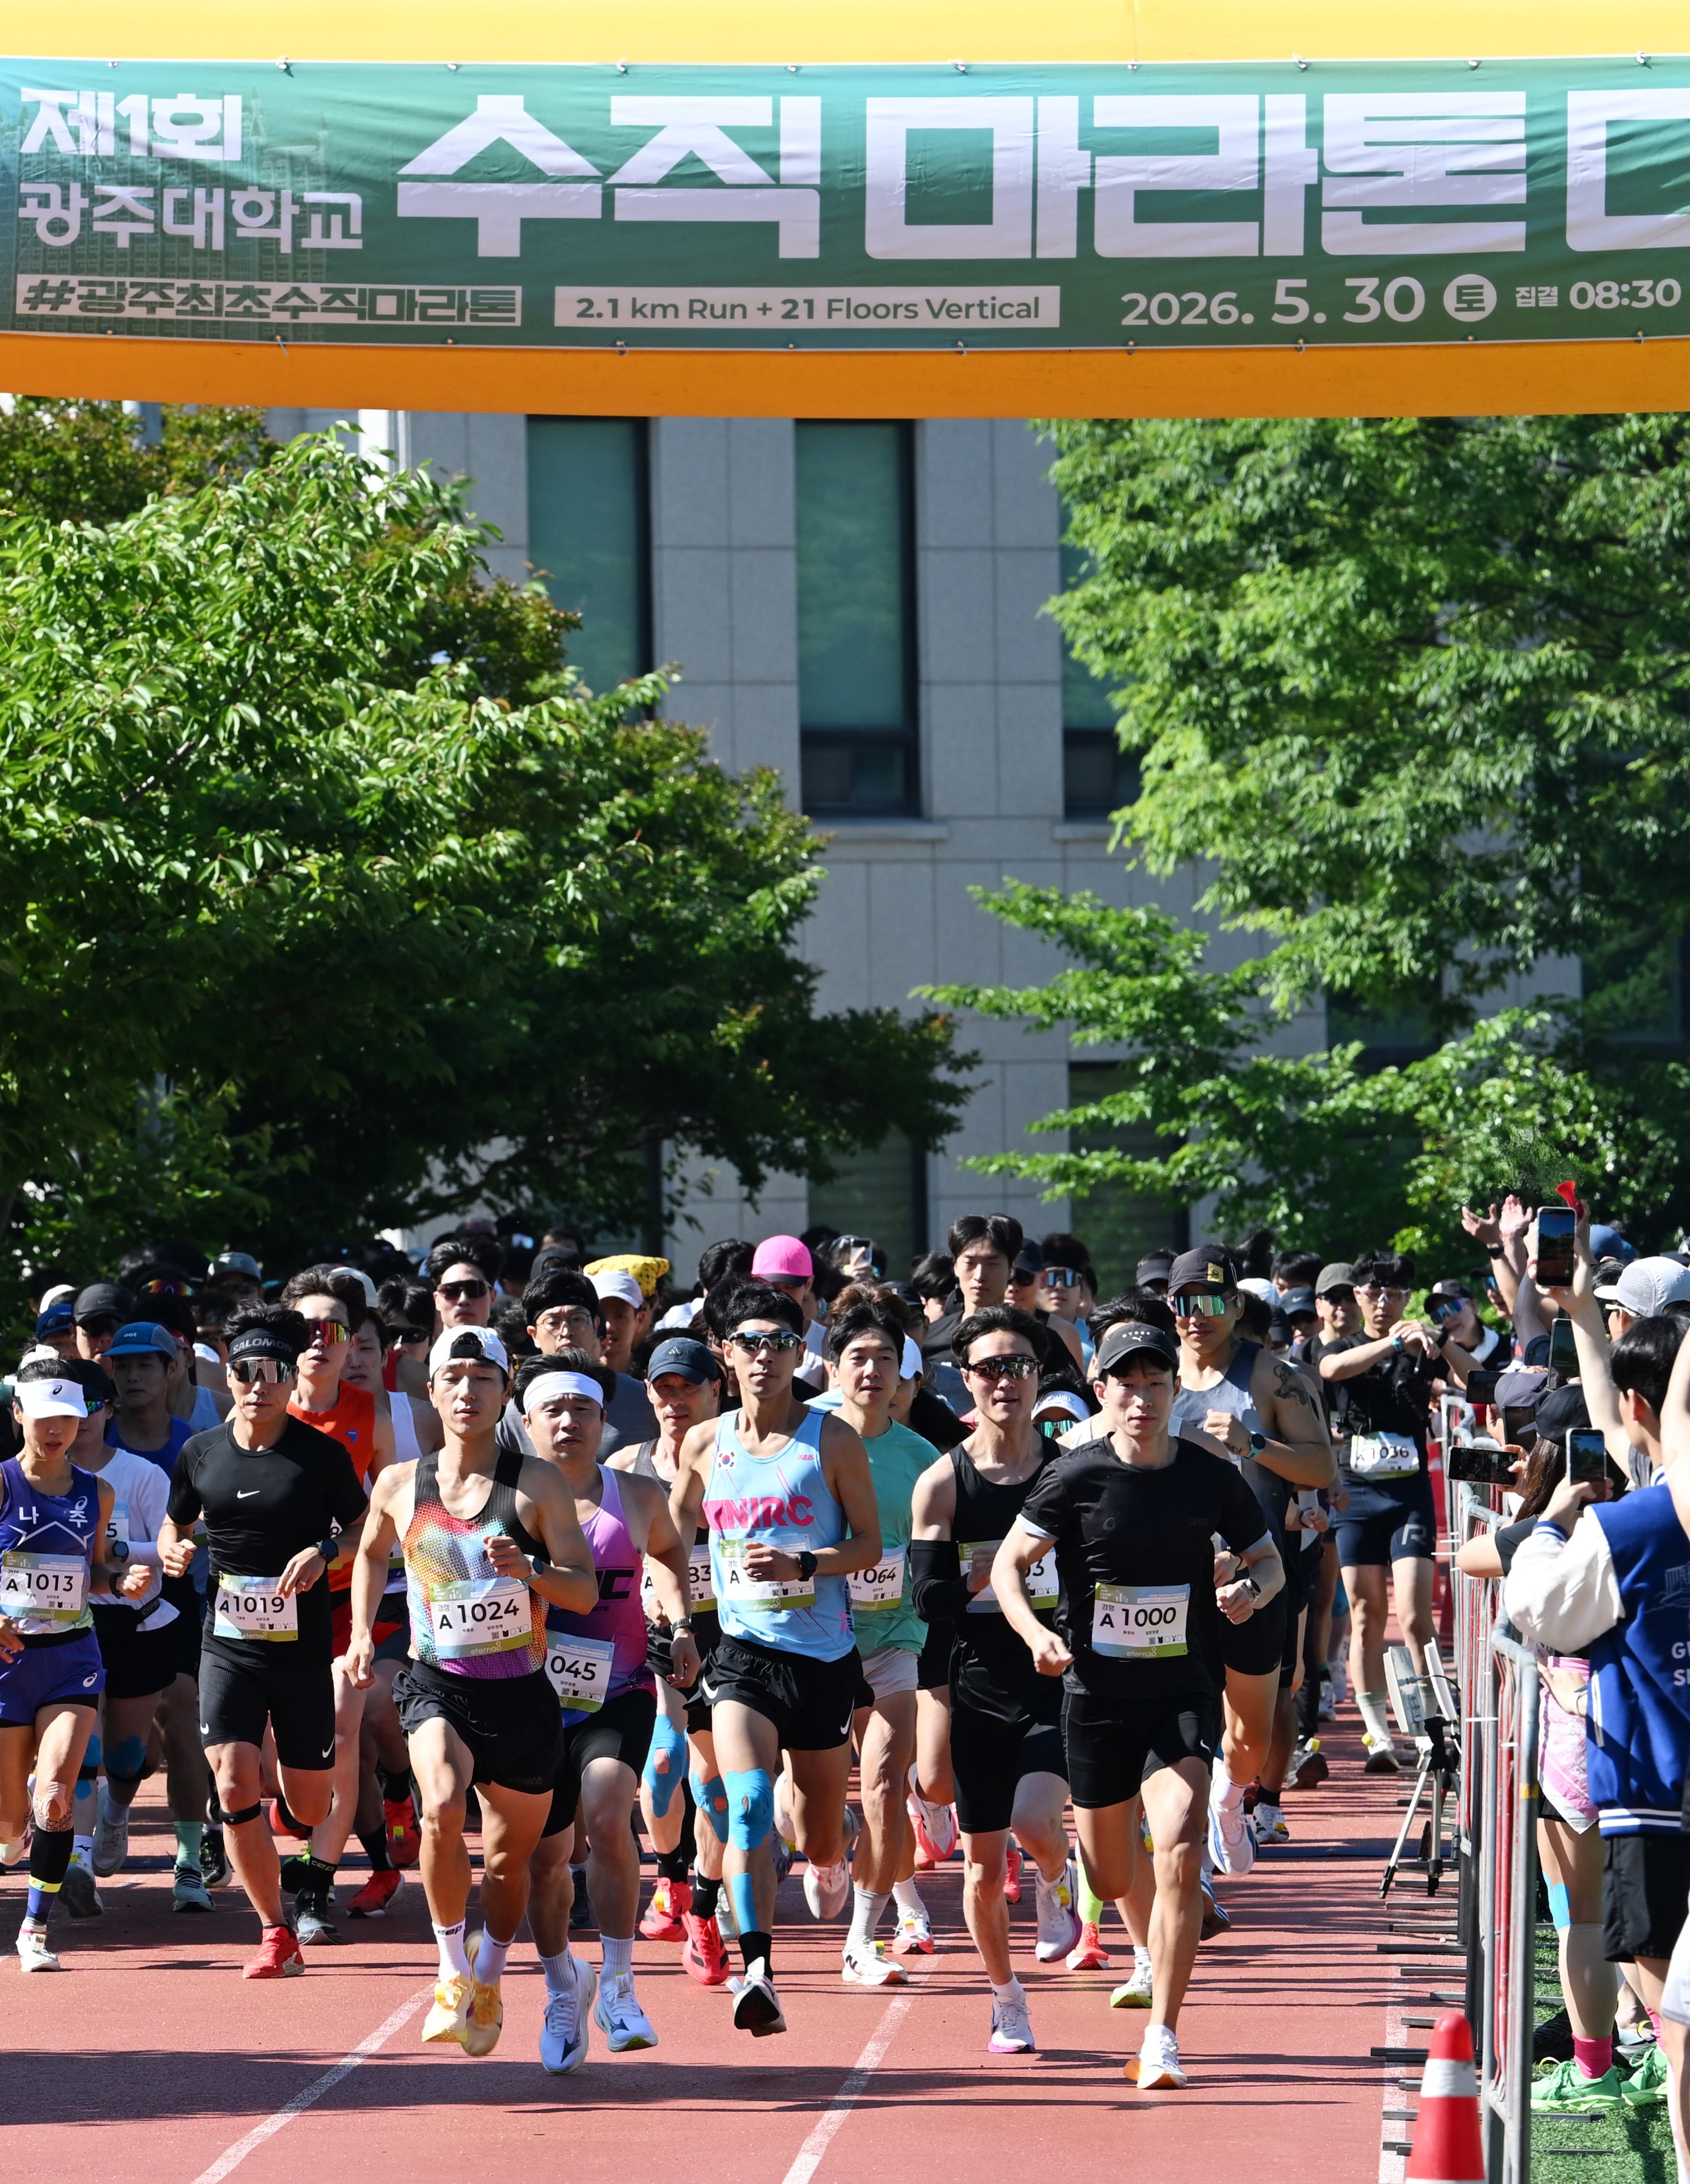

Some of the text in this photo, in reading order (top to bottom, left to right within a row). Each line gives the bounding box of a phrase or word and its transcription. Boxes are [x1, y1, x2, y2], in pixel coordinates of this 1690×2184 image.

[20, 87, 242, 161] 제1회
[396, 95, 821, 258] 수직
[865, 91, 1526, 259] 마라톤
[18, 183, 363, 253] 광주대학교
[22, 279, 517, 323] #광주최초수직마라톤
[576, 297, 619, 319] 2.1
[631, 296, 679, 319] km
[688, 298, 747, 319] Run
[781, 298, 814, 319] 21
[827, 297, 919, 319] Floors
[924, 296, 1039, 319] Vertical
[1121, 292, 1254, 326] 2026.
[1271, 278, 1327, 324] 5.
[1342, 275, 1425, 323] 30
[1515, 285, 1558, 308] 집결
[1569, 278, 1681, 310] 08:30
[232, 1337, 293, 1354] SALOMON
[6, 1572, 74, 1592] A 1013
[730, 1570, 740, 1584] A
[219, 1595, 284, 1614] A 1019
[439, 1598, 520, 1630] A 1024
[1099, 1606, 1177, 1629] A 1000
